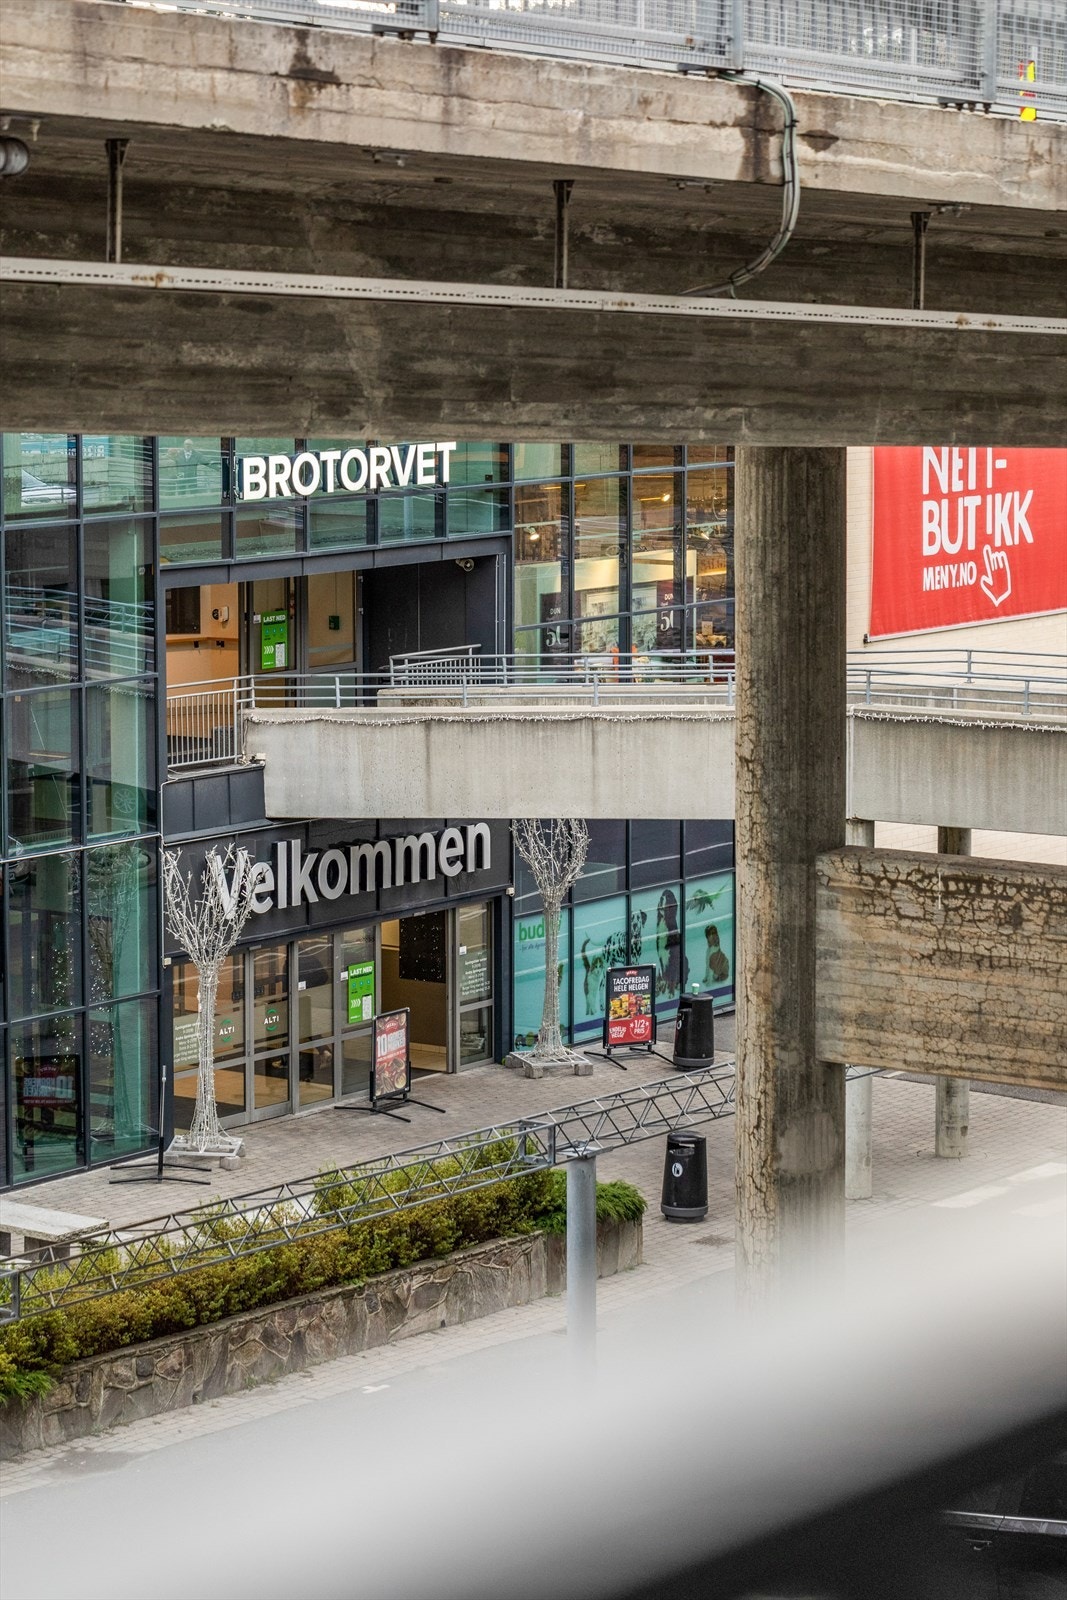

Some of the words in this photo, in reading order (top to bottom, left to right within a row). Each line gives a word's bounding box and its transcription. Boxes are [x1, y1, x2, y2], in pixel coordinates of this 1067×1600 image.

[242, 441, 457, 501] BROTORVET
[922, 489, 1034, 556] BUTIKK
[922, 561, 978, 591] MENY.NO
[215, 822, 491, 920] Velkommen
[350, 967, 363, 976] LAST
[613, 975, 650, 985] TACOFREDAG
[628, 983, 649, 991] HELGEN
[263, 1015, 280, 1025] ALTI
[634, 1019, 646, 1028] 1/2
[218, 1026, 235, 1036] ALTI
[376, 1033, 388, 1058] 10
